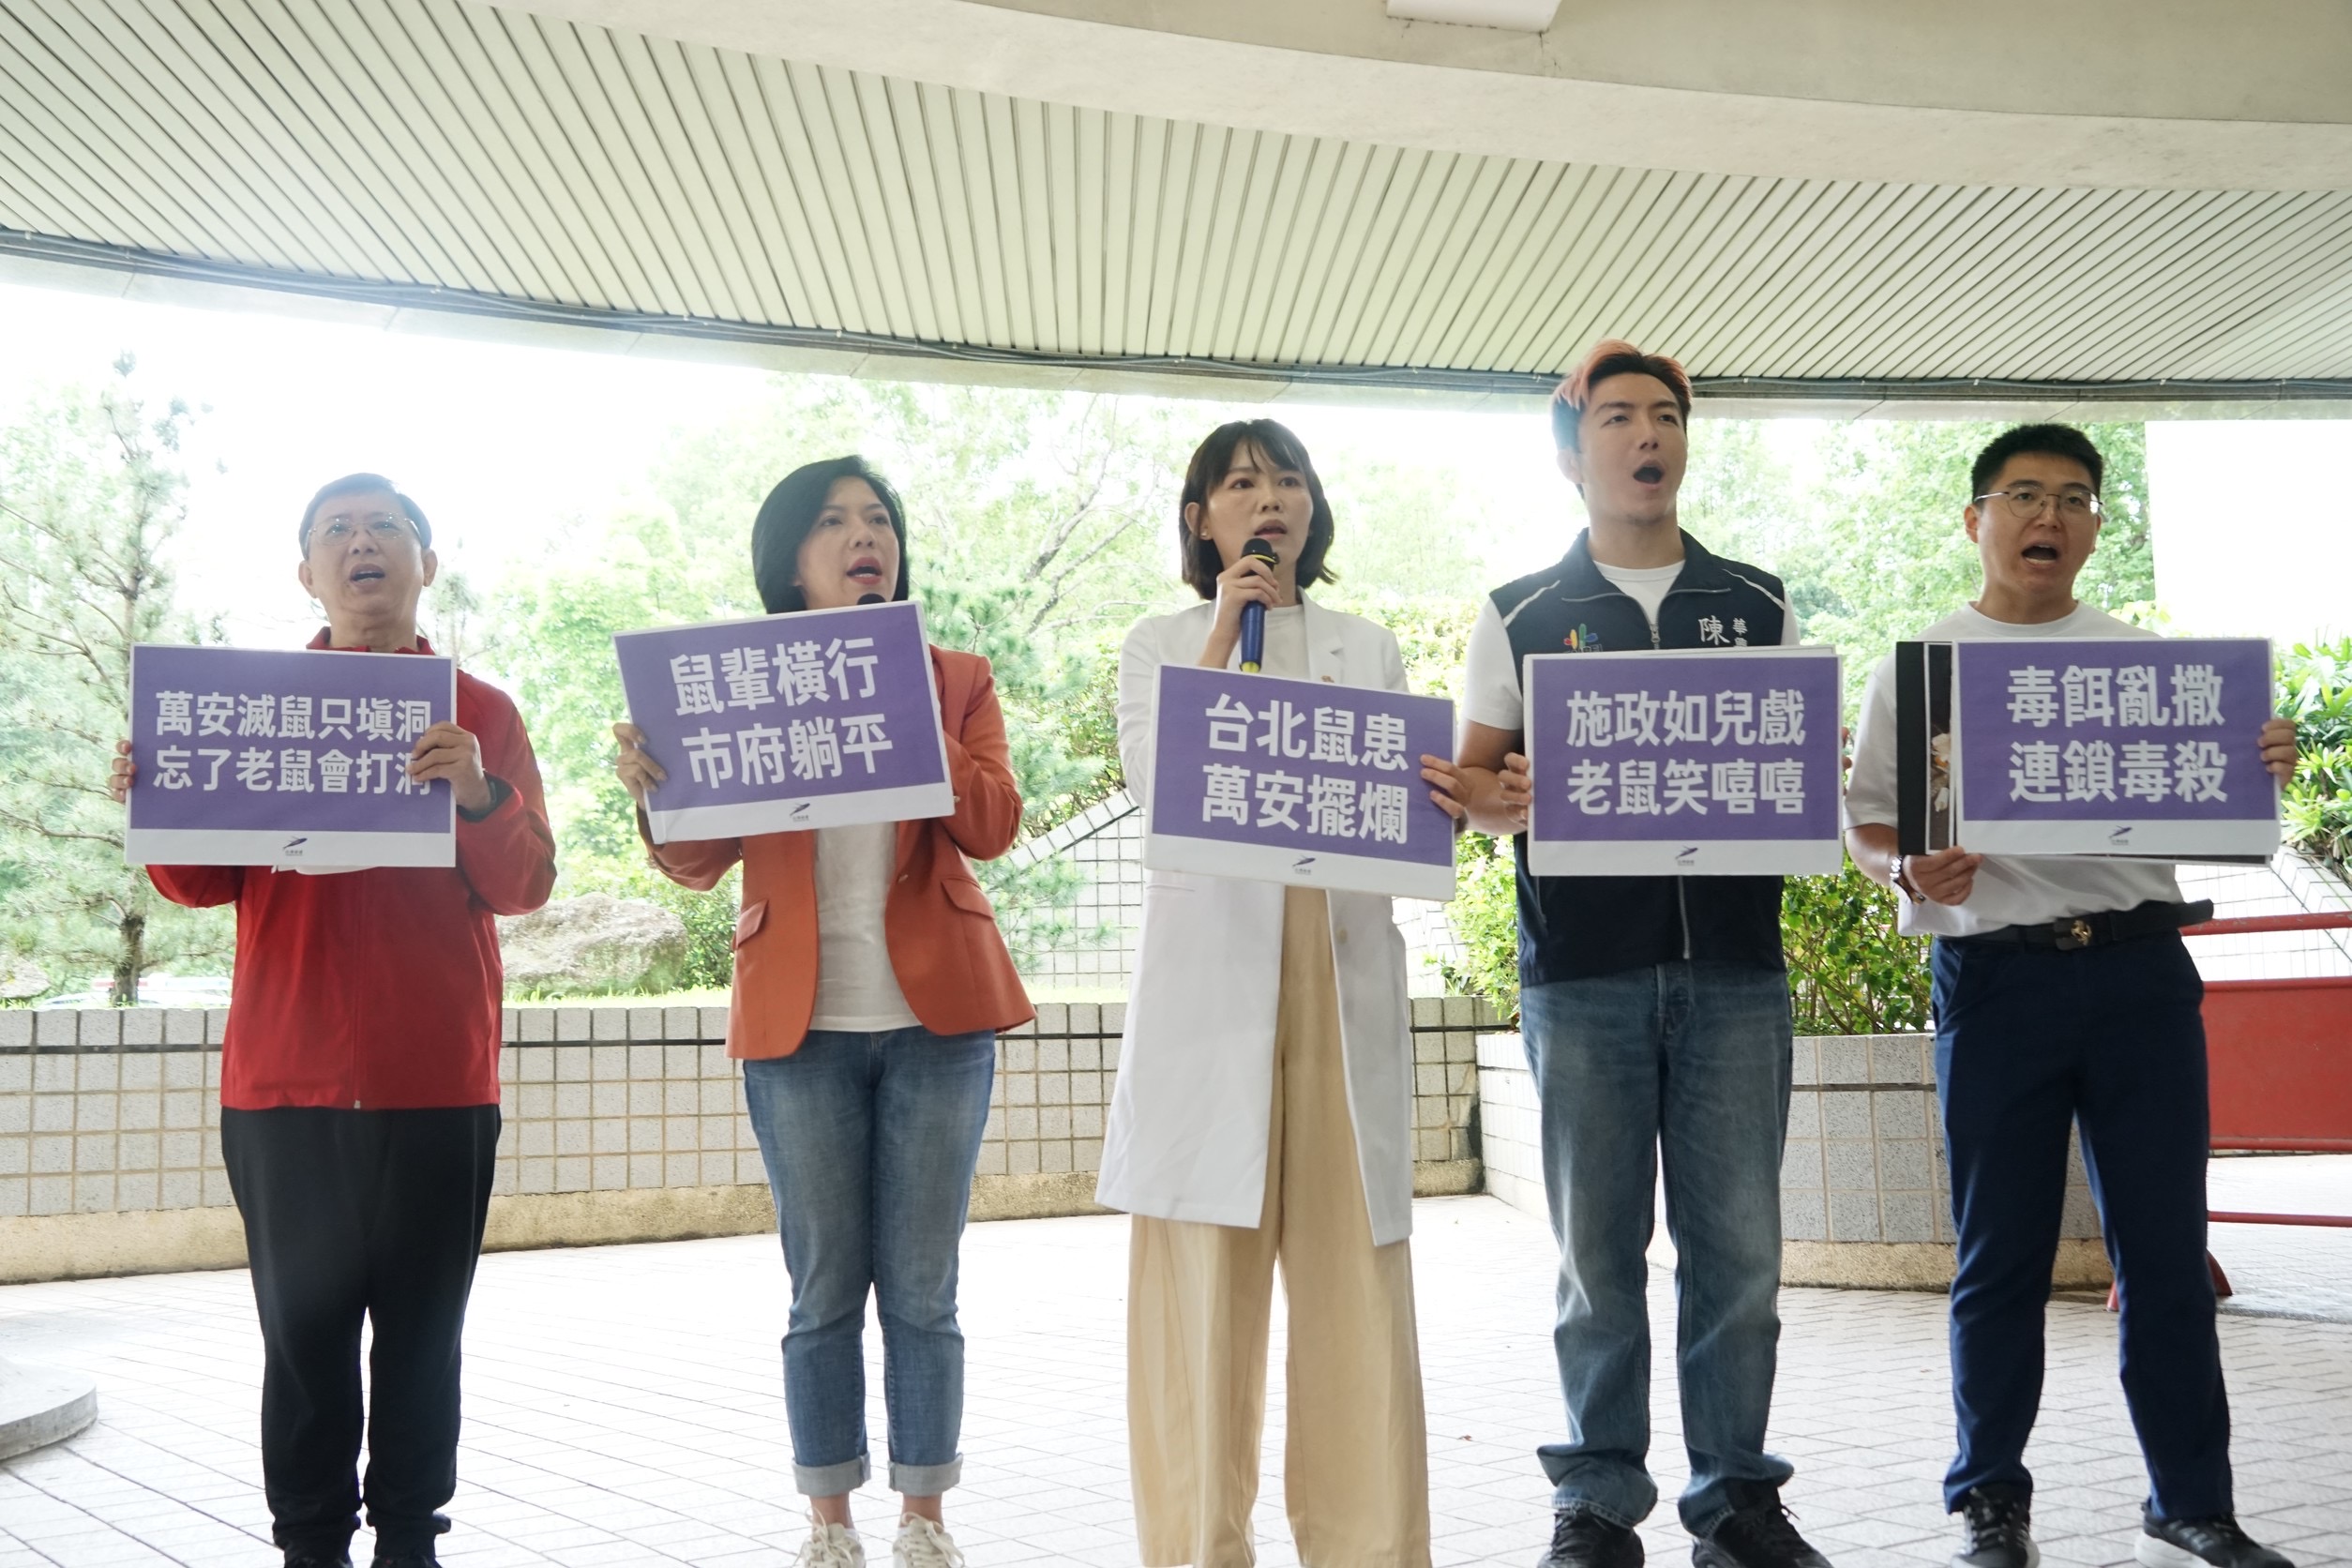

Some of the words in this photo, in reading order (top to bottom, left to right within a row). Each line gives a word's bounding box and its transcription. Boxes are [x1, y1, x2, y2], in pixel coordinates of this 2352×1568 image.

[1697, 614, 1730, 646] 陳
[670, 637, 879, 716] 鼠輩橫行
[2006, 664, 2225, 728] 毒餌亂撒
[1205, 692, 1409, 771] 台北鼠患
[1566, 689, 1806, 747] 施政如兒戲
[681, 713, 893, 789] 市府躺平
[2008, 740, 2229, 803] 連鎖毒殺
[1201, 763, 1409, 844] 萬安擺爛
[1566, 758, 1806, 816] 老鼠笑嘻嘻
